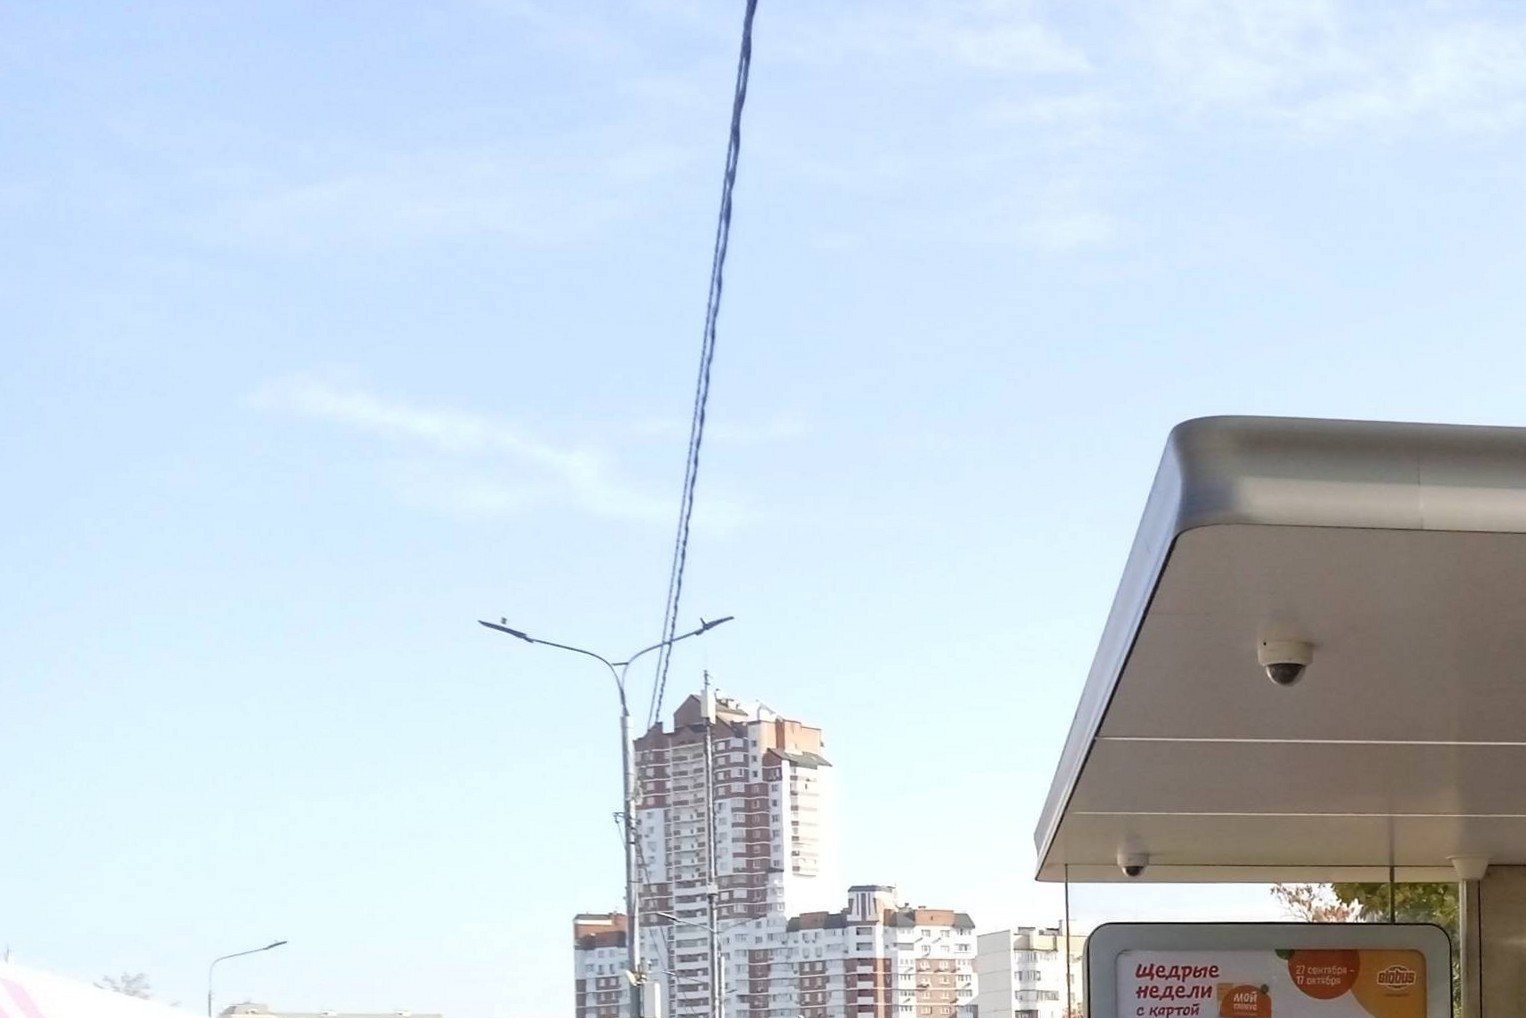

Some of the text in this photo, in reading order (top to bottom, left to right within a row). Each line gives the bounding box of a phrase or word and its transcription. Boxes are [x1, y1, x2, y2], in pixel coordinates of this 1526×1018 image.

[1136, 963, 1220, 982] Щедрые
[1296, 965, 1305, 975] 27
[1307, 965, 1347, 976] сентября
[1296, 975, 1341, 986] 17 октября
[1136, 985, 1212, 1000] недели
[1136, 1003, 1200, 1018] с картой
